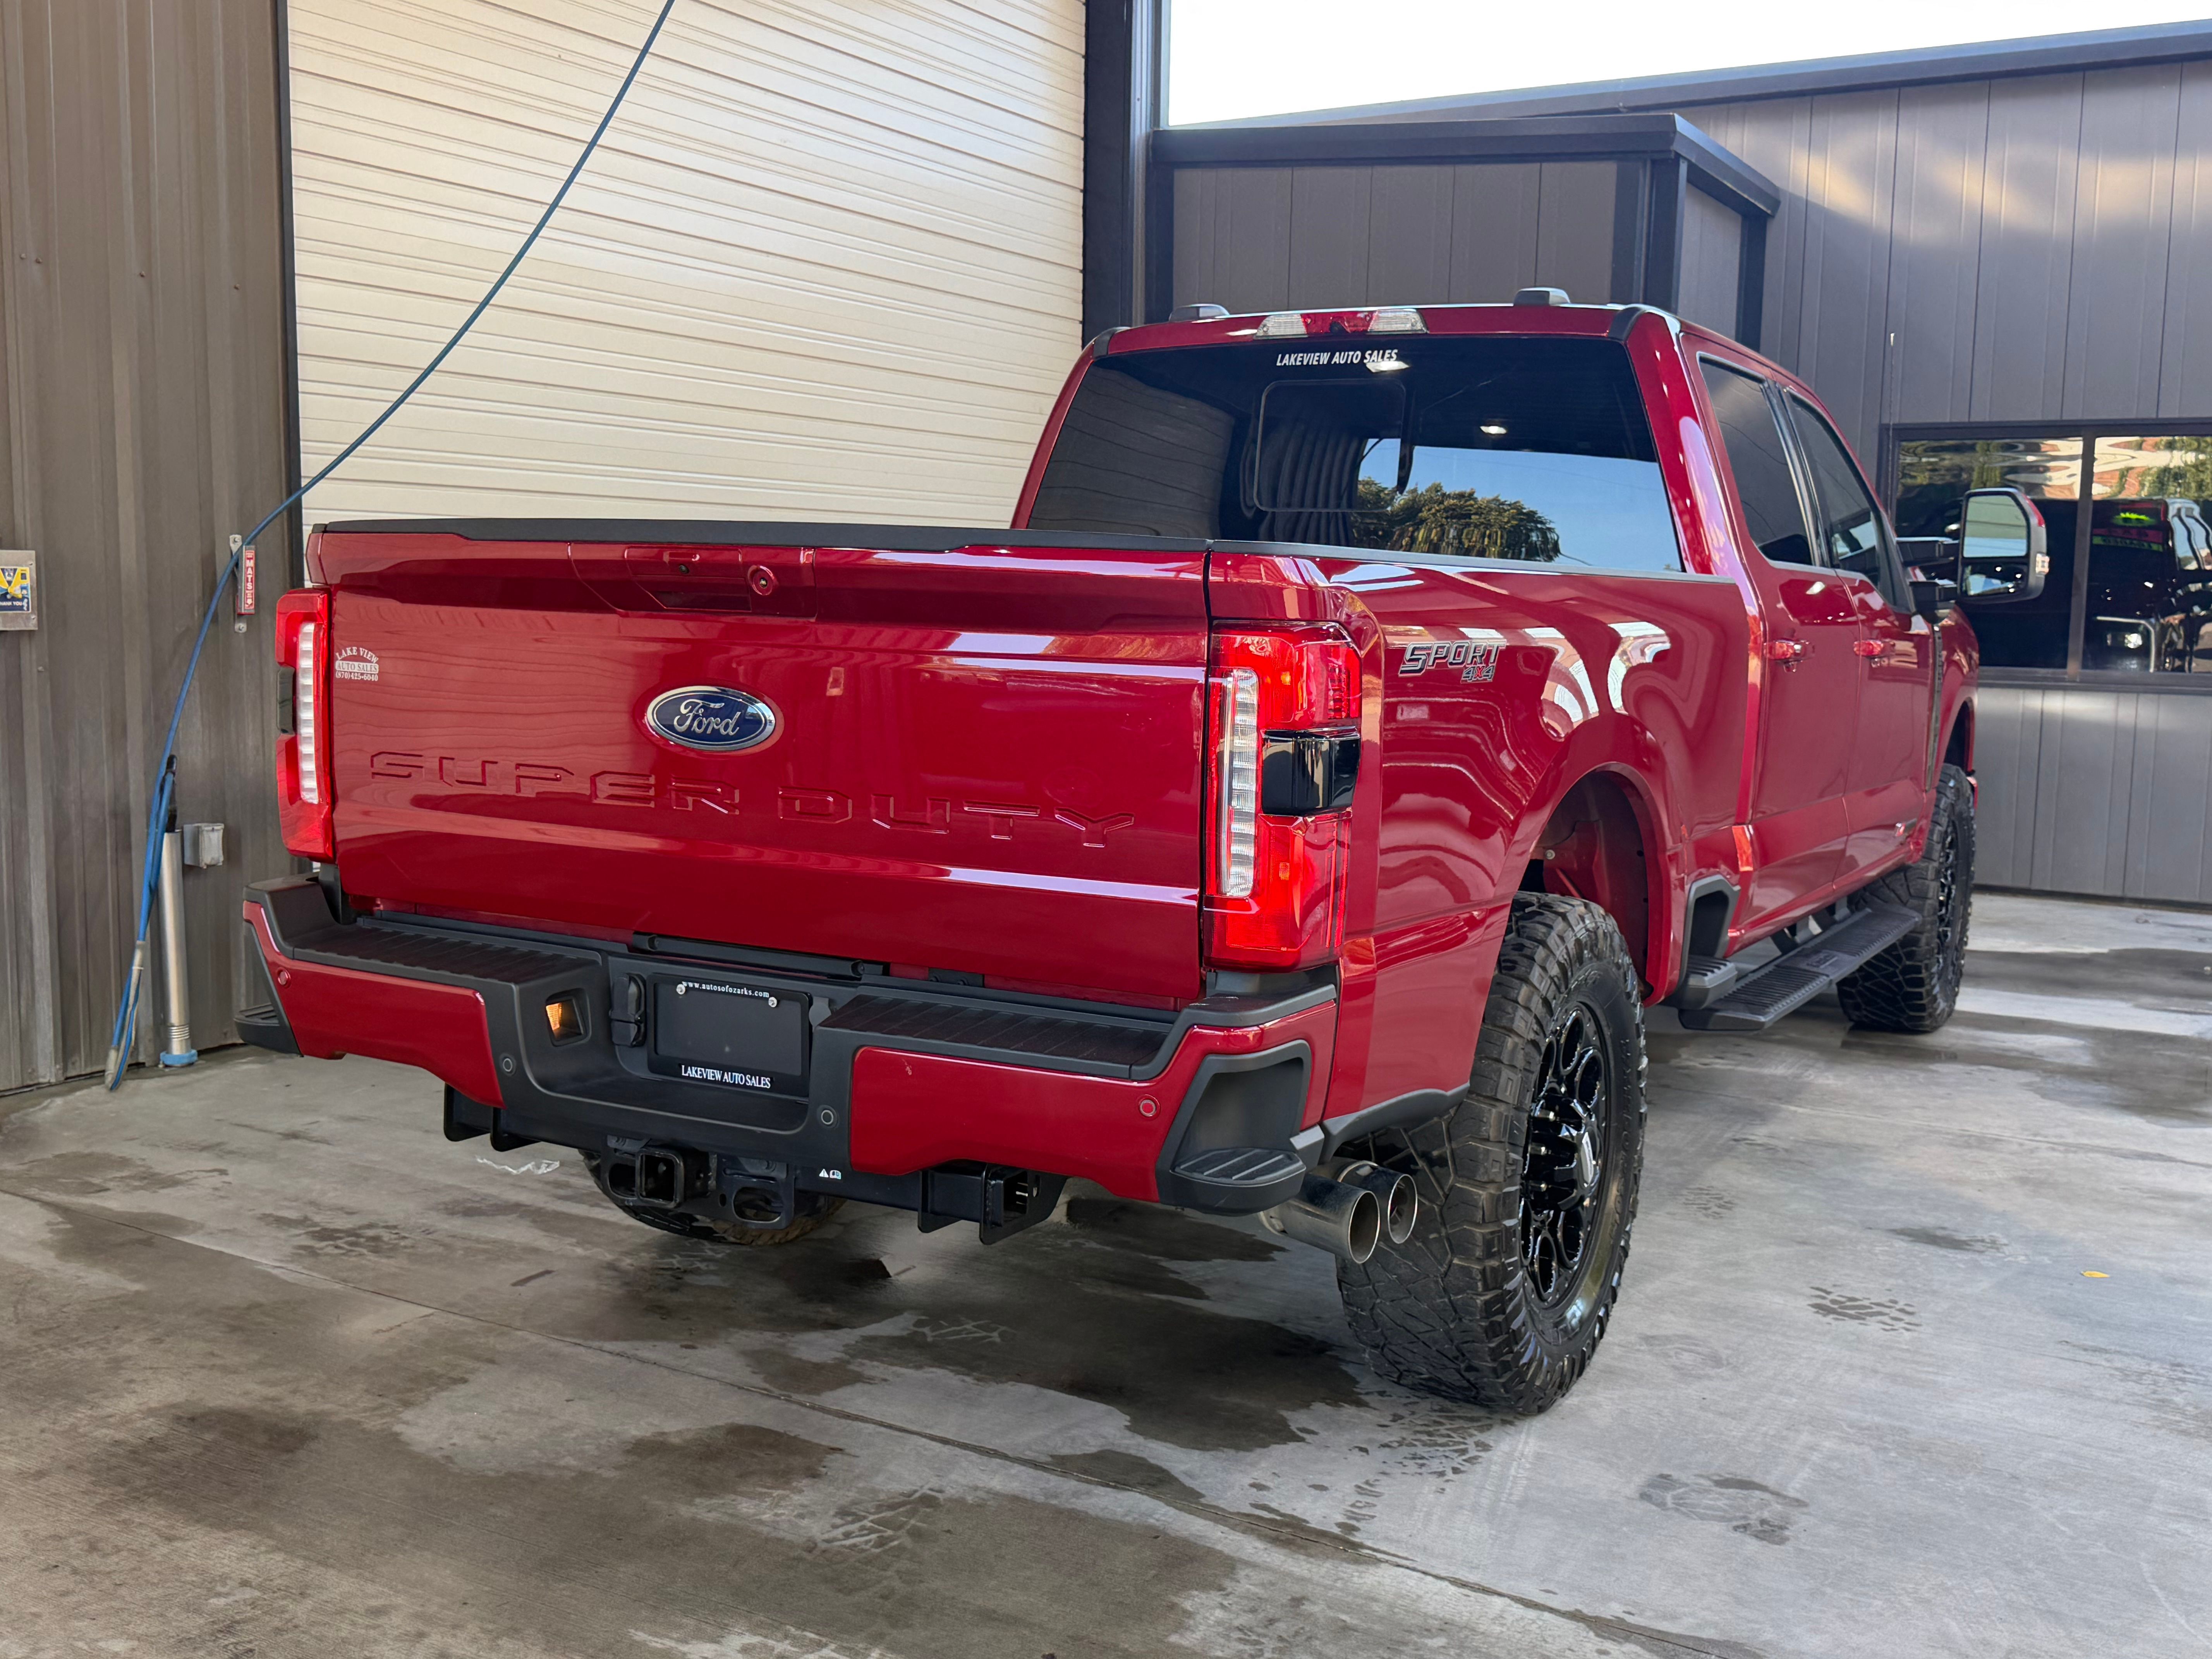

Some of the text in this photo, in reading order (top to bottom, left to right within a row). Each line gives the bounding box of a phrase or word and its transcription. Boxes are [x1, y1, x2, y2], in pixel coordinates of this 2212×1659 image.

[1276, 349, 1398, 366] LAKEVIEW AUTO SALES
[335, 647, 379, 663] LAKE VIEW
[1398, 639, 1507, 678] SPORT
[357, 663, 378, 672] SALES
[674, 699, 741, 736] Ford
[371, 750, 1135, 848] SUPER DUTY
[682, 981, 769, 998] www.autosofozarks.com
[682, 1065, 771, 1089] LAKEVIEW AUTO SALES
